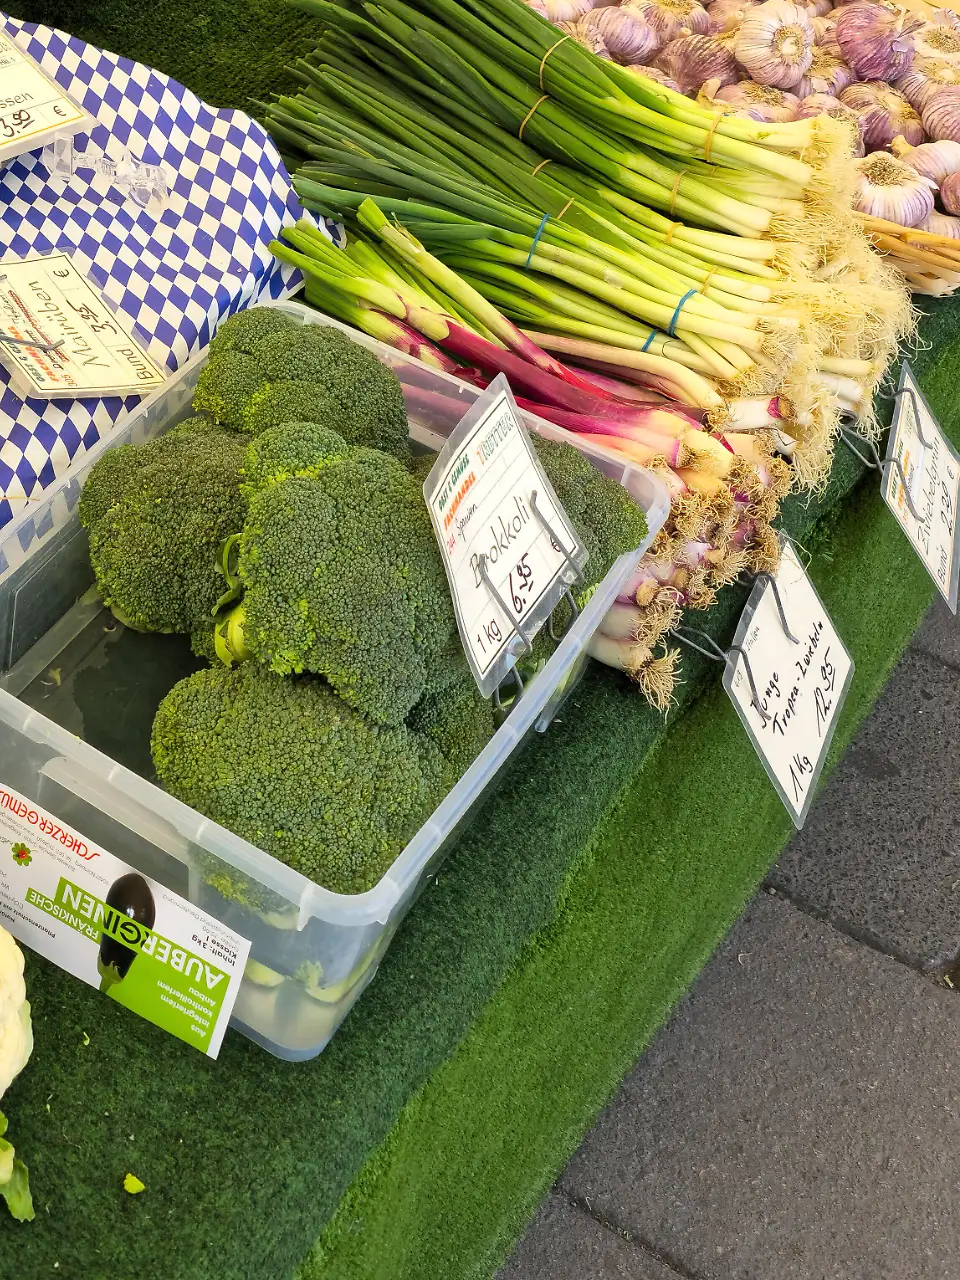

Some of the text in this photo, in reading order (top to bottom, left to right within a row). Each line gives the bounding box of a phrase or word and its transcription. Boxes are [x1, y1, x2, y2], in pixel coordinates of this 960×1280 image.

[53, 106, 67, 117] €
[52, 270, 70, 279] €
[28, 281, 110, 368] Mairüben
[116, 348, 155, 381] Bund
[451, 452, 470, 487] GEMÜSE
[947, 465, 956, 479] €
[443, 471, 477, 532] FACHHANDEL
[918, 435, 941, 556] Zwiebelgrün
[470, 495, 531, 589] Brokkoli
[937, 545, 948, 585] Bund
[476, 552, 534, 654] 1 kg 6.95
[771, 679, 801, 738] Tropea
[814, 646, 838, 738] 12.95
[29, 888, 99, 940] FRÄNKISCHE
[61, 887, 225, 989] AUBERGINEN
[206, 946, 235, 966] Inhalt:
[211, 937, 237, 958] Klasse
[157, 980, 213, 1017] kontrolliertem
[160, 995, 210, 1027] integriertem
[188, 987, 216, 1005] Anbau
[191, 1024, 207, 1037] Aus
